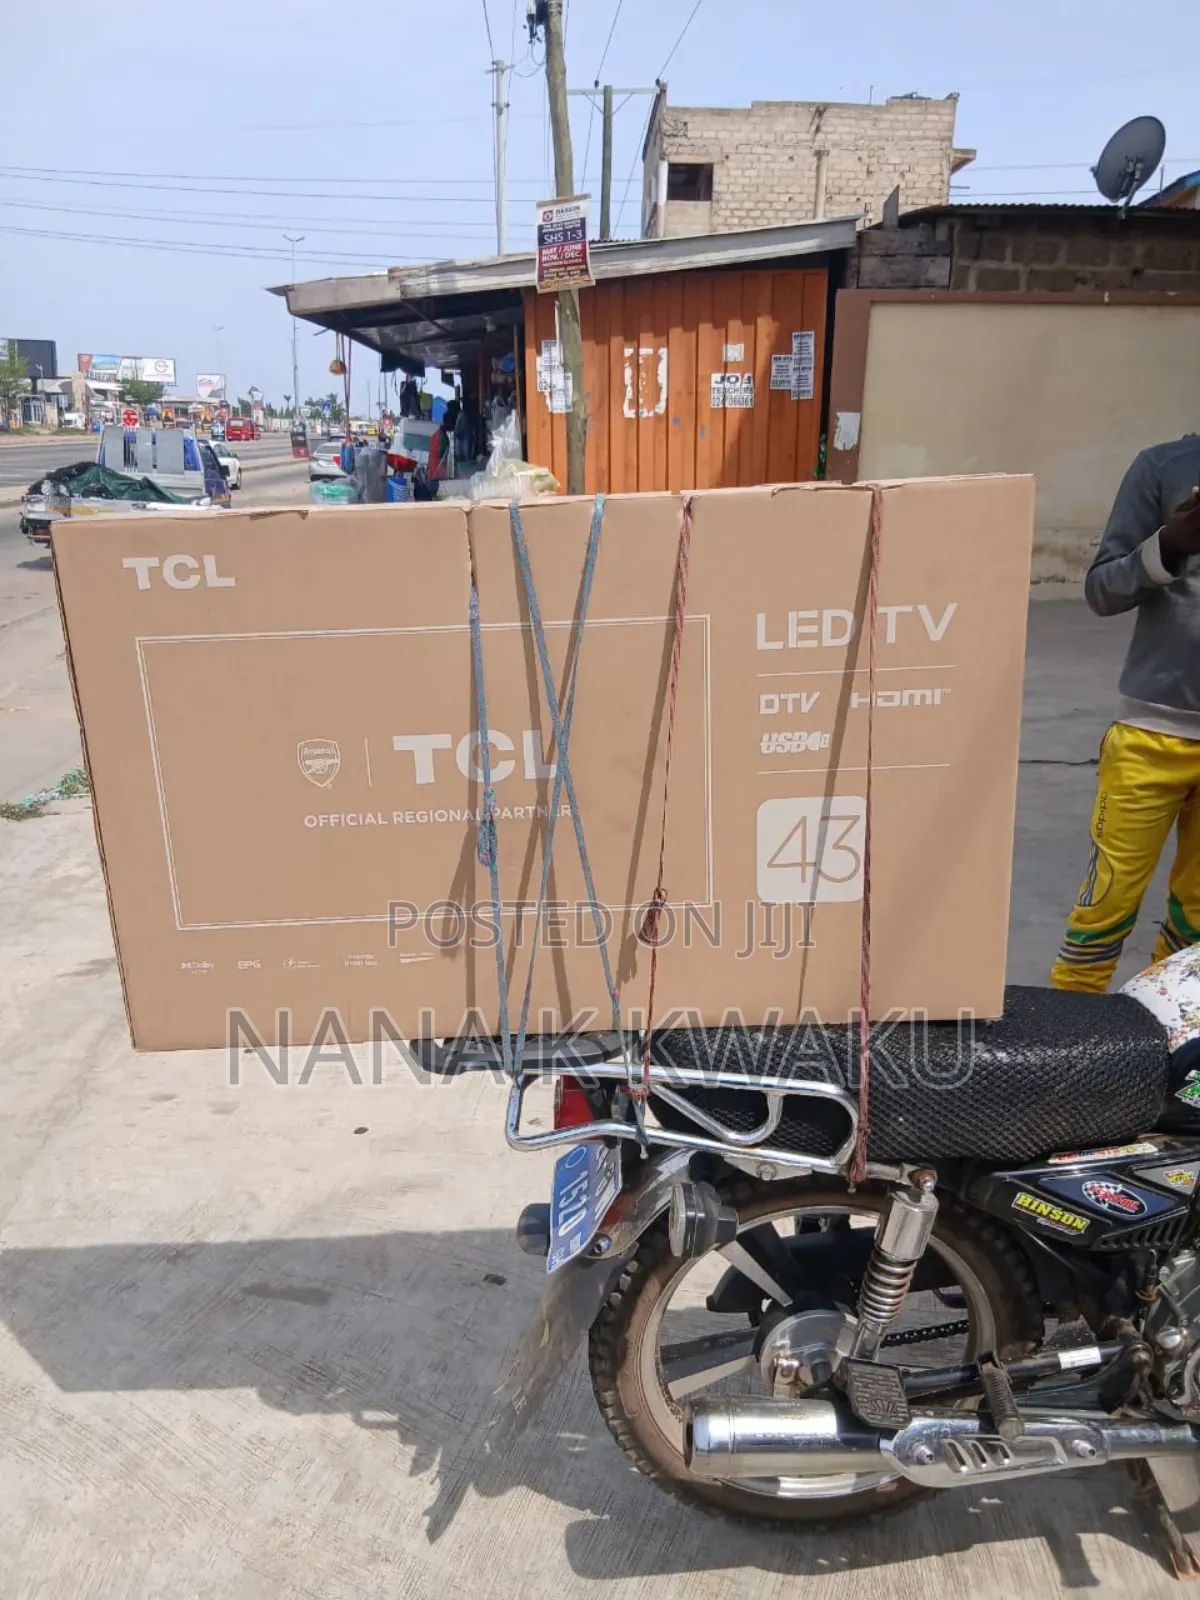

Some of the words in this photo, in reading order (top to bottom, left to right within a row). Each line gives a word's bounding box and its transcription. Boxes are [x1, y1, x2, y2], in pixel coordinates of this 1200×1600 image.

[544, 231, 564, 245] SHS
[122, 554, 236, 590] TCL
[756, 608, 855, 651] LED
[876, 602, 958, 644] TV
[759, 691, 820, 715] DTV
[393, 729, 559, 785] TCL
[760, 732, 807, 754] USB
[304, 811, 389, 828] OFFICIAL
[767, 815, 861, 883] 43
[238, 960, 261, 970] EPG
[1017, 1194, 1087, 1230] HINSON
